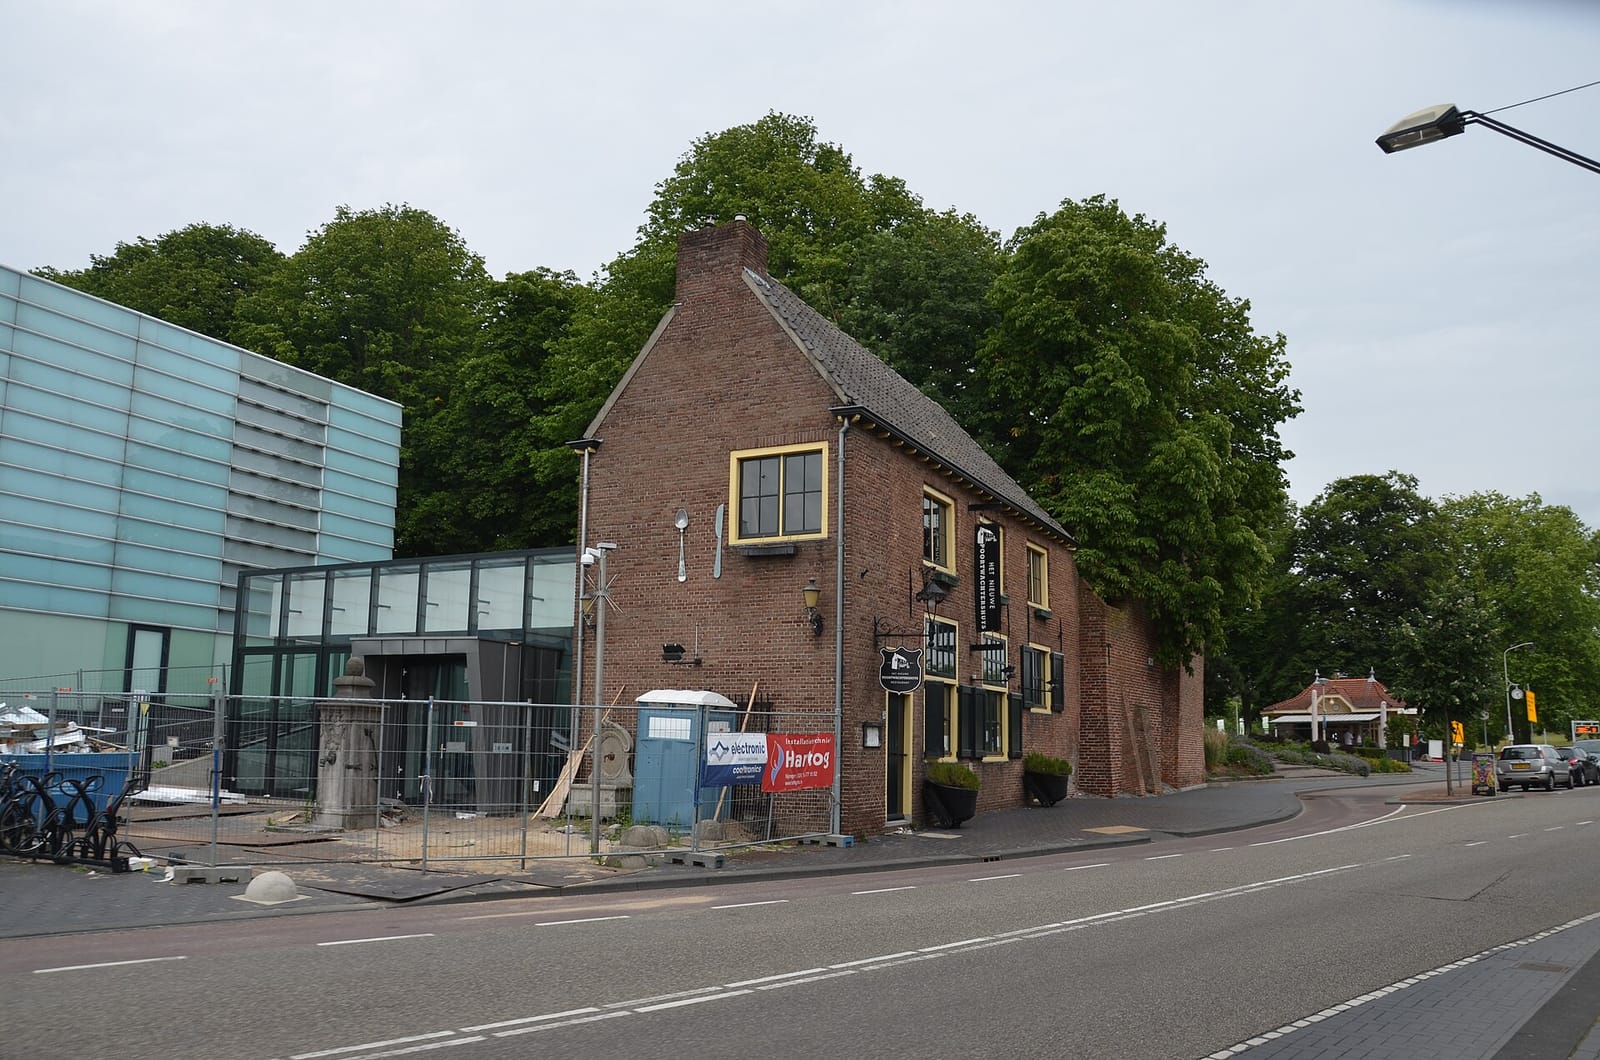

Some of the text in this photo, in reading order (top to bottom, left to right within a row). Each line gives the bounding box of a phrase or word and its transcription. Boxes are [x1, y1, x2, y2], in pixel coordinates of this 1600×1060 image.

[979, 543, 987, 630] POORTWACHTERSHUYS
[731, 741, 766, 754] electronic
[785, 750, 830, 769] Hartog
